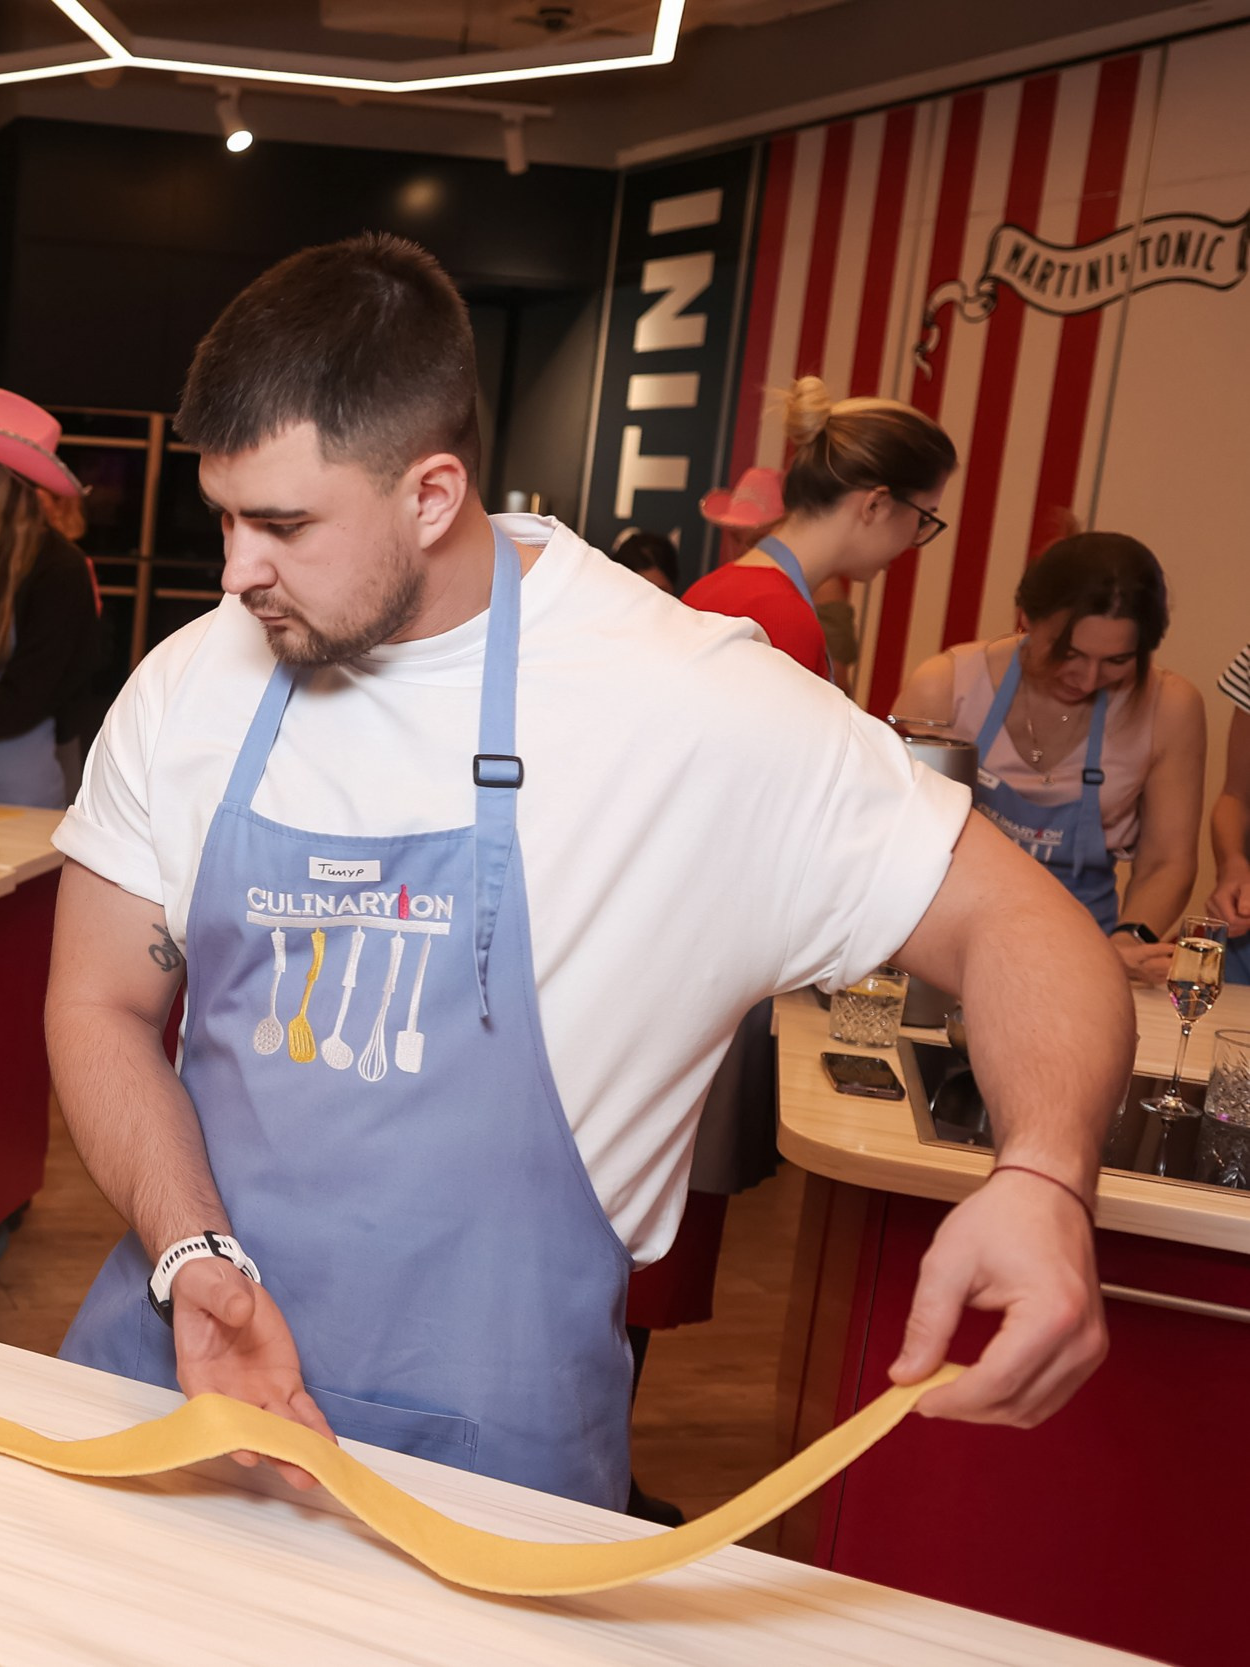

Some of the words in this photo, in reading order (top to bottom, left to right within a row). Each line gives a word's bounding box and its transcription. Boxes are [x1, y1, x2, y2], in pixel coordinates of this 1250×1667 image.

[612, 187, 723, 552] TINI
[1005, 241, 1114, 298] MARTINI
[1138, 231, 1225, 273] TONIC
